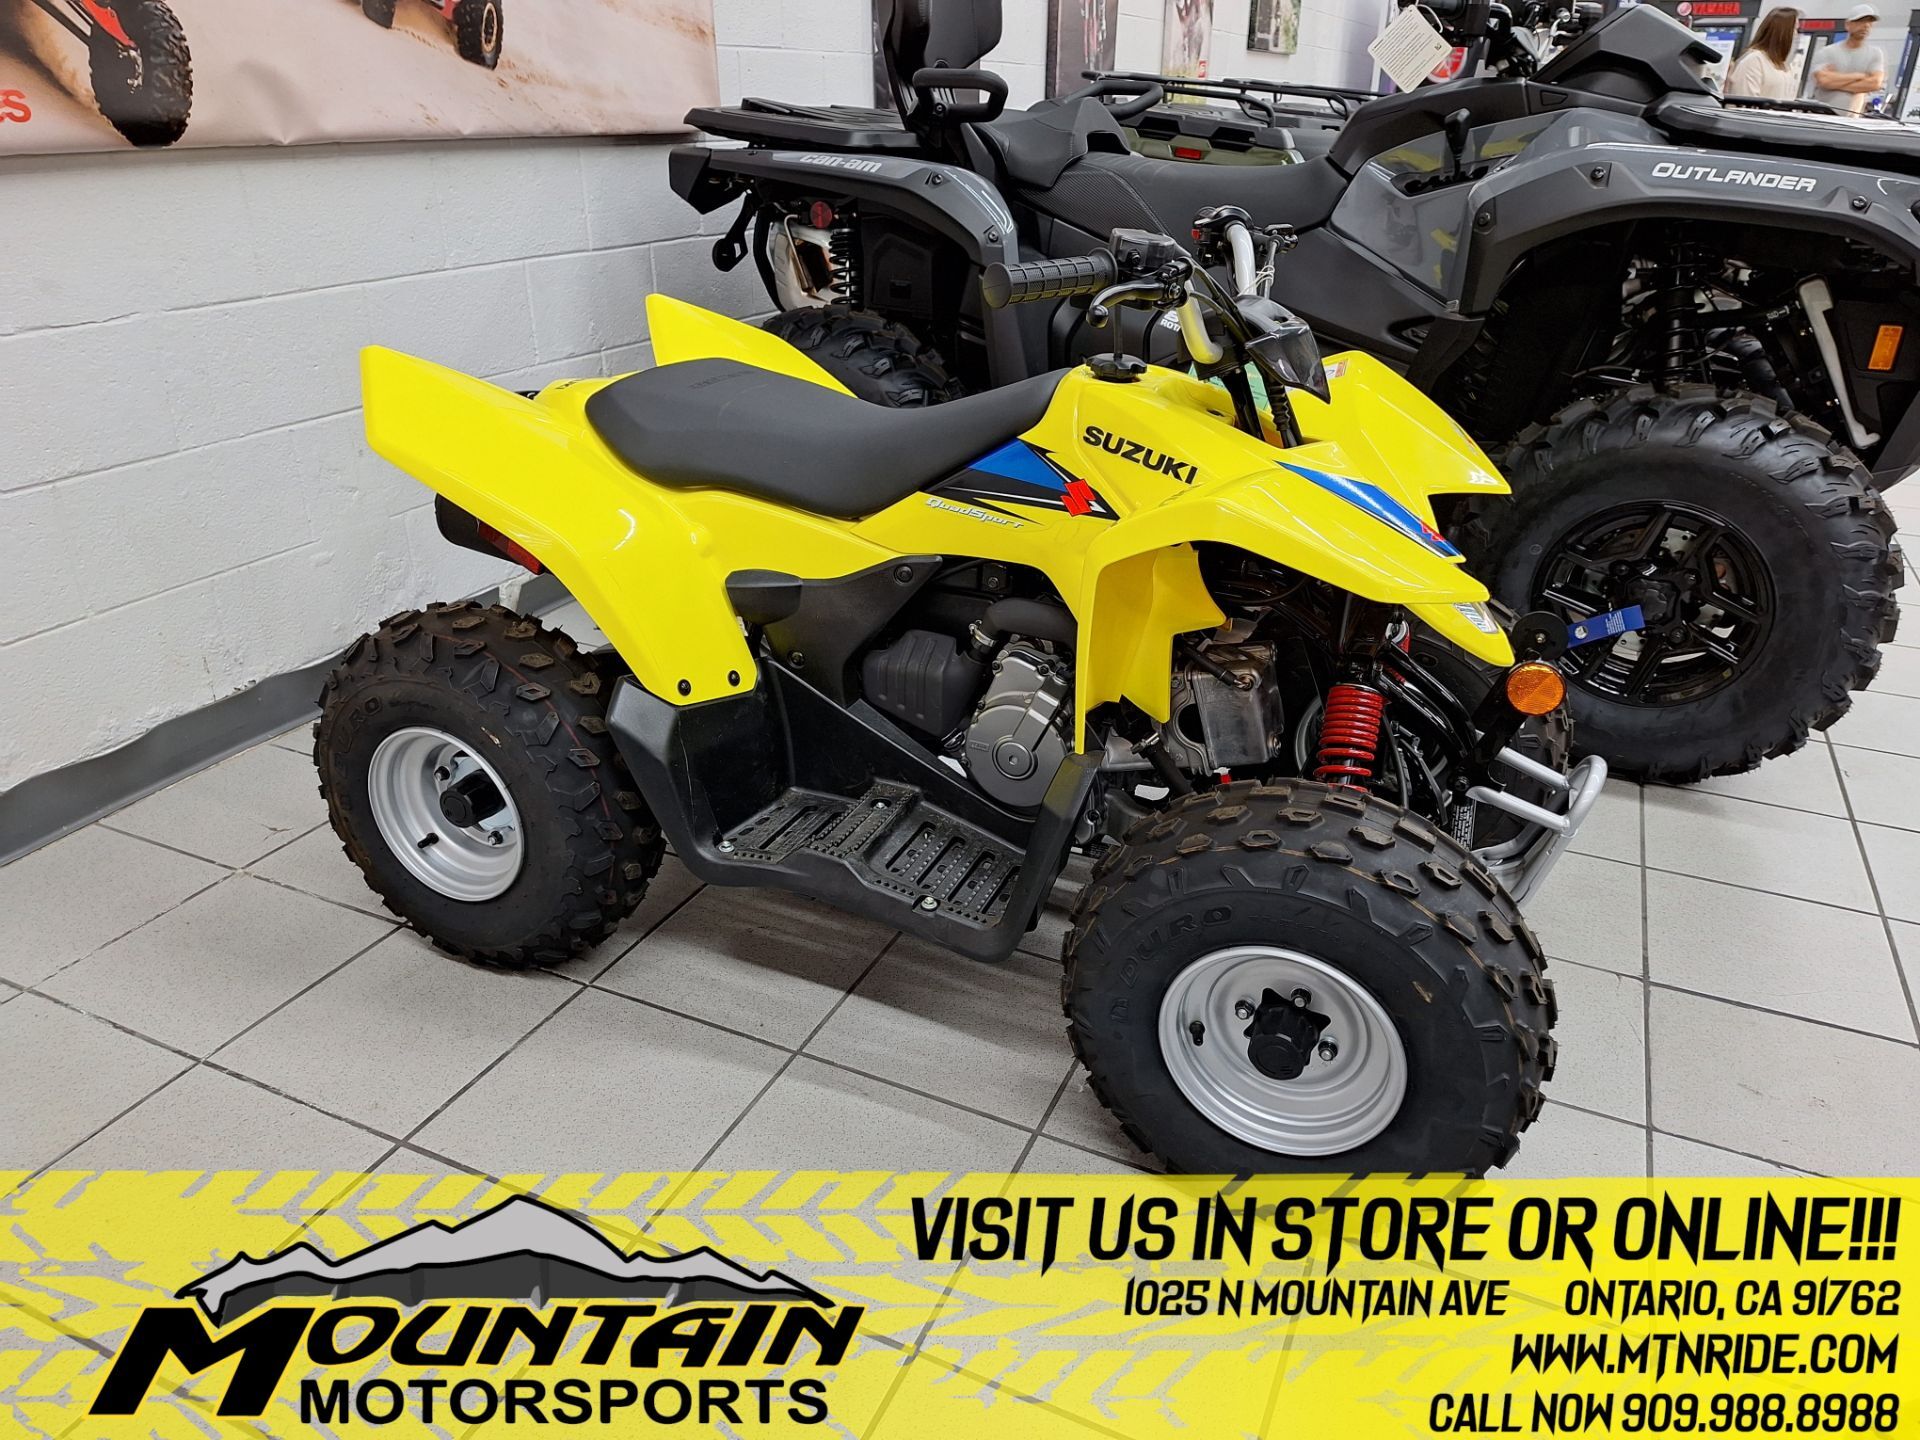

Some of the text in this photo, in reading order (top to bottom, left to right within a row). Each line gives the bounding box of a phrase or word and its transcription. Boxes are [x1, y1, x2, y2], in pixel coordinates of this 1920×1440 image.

[800, 154, 882, 173] can-am
[1651, 162, 1817, 192] OUTLANDER
[1083, 425, 1198, 485] SUZUKI
